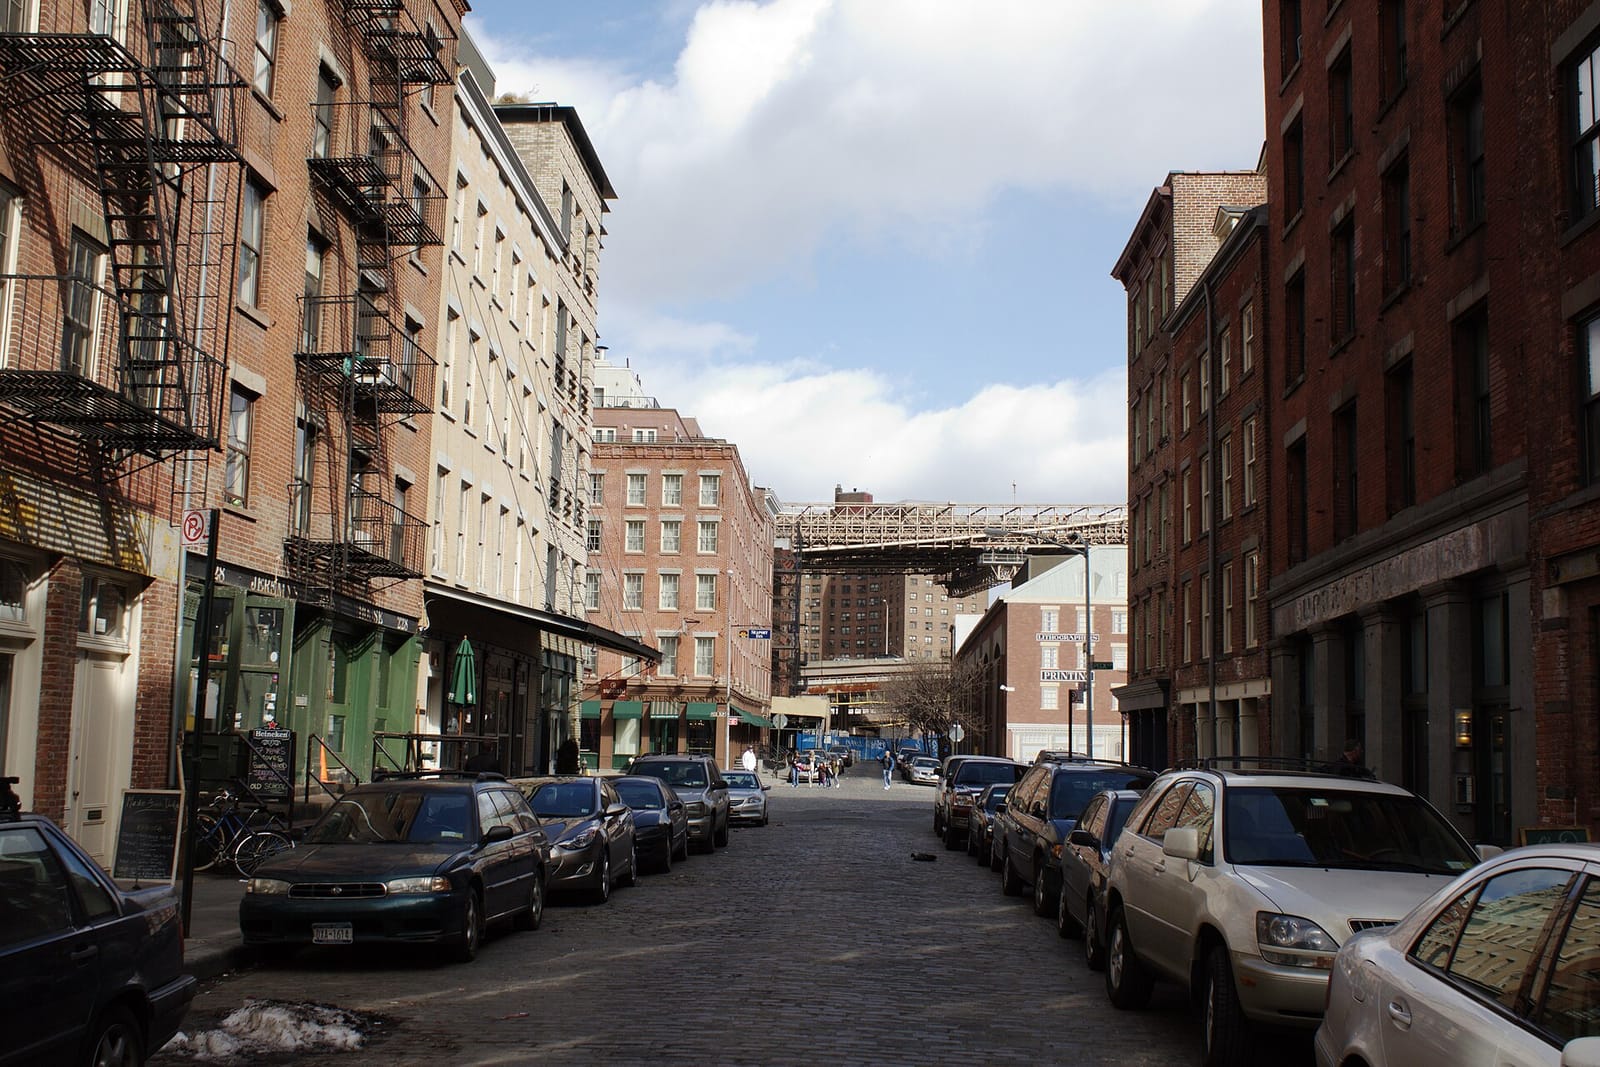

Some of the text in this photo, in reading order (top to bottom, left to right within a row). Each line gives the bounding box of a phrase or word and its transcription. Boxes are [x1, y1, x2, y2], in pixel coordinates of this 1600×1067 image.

[639, 695, 675, 703] WESTERN
[675, 695, 712, 704] SEAPORT
[712, 696, 727, 704] INN
[255, 730, 288, 738] Heineken
